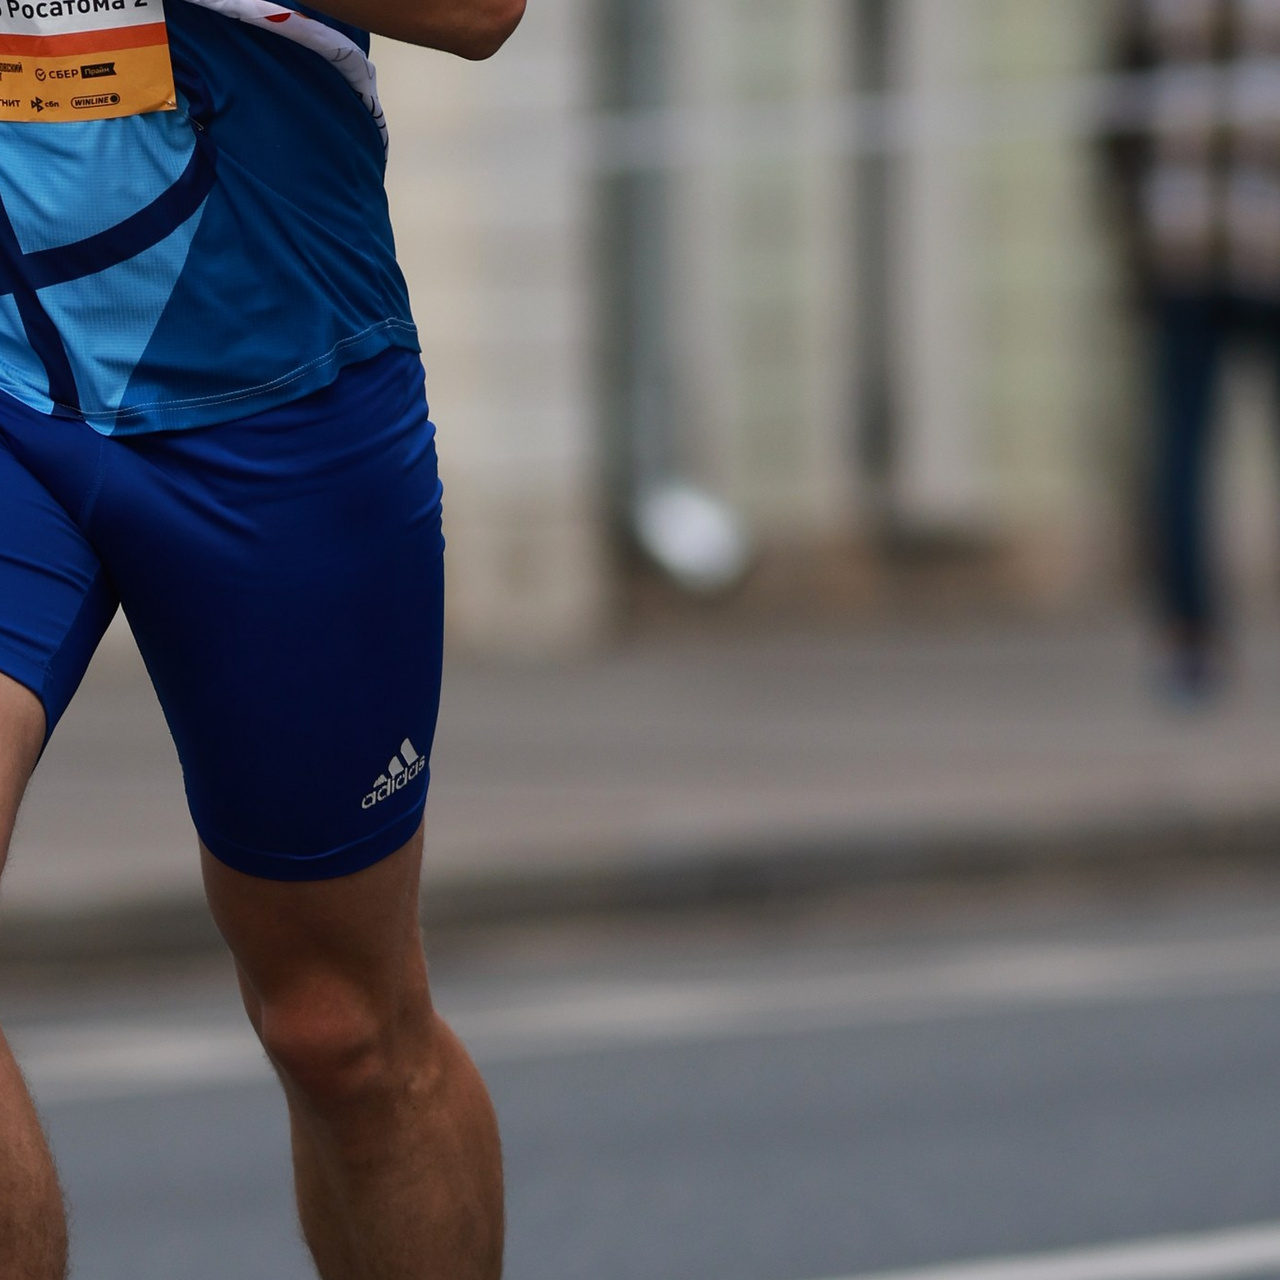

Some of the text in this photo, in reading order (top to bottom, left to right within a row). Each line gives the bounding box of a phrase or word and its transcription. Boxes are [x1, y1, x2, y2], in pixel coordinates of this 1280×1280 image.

[48, 68, 79, 79] СБЕР
[74, 96, 109, 106] WINLINE
[361, 755, 426, 809] adidas
